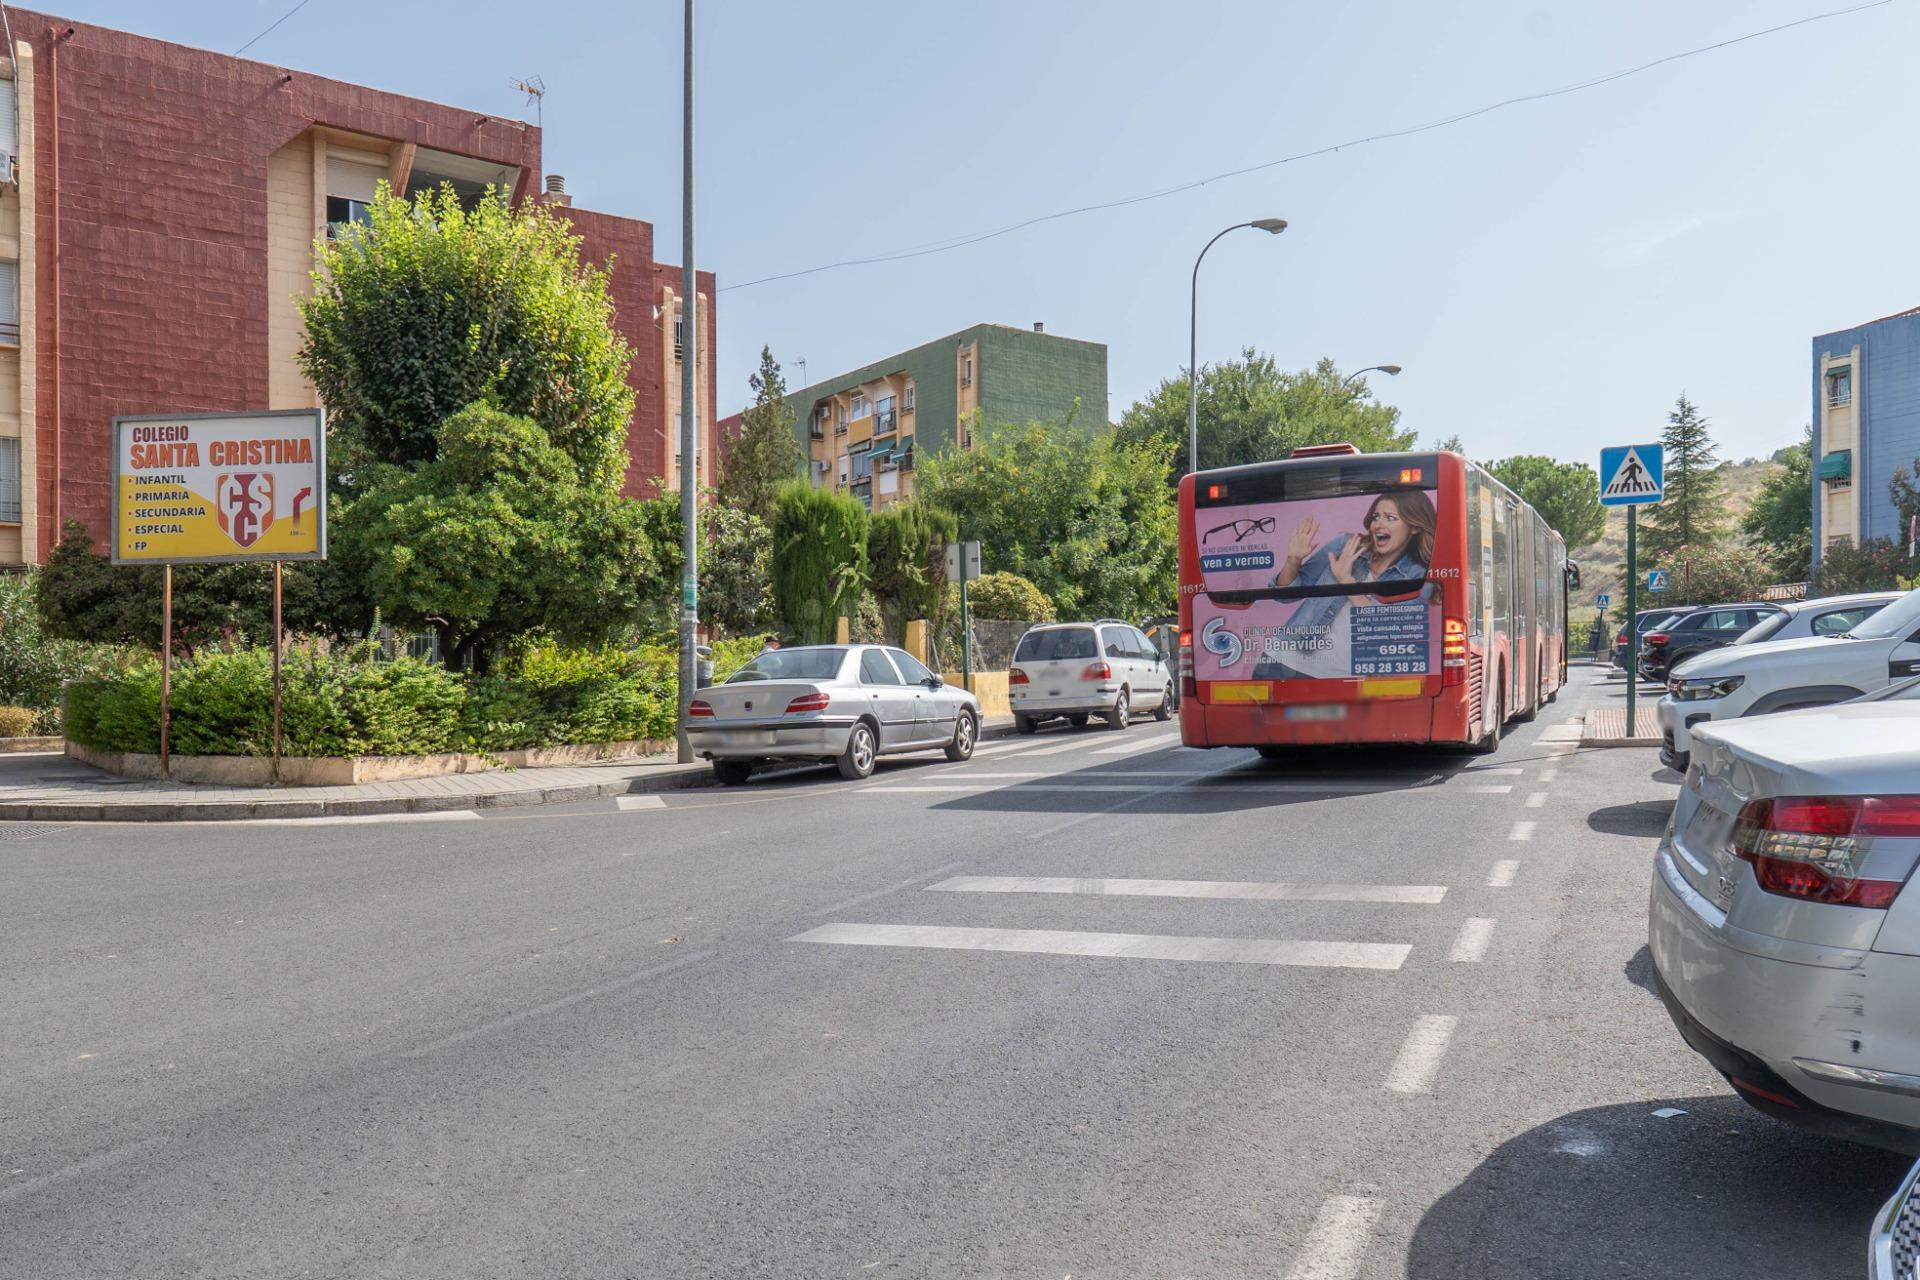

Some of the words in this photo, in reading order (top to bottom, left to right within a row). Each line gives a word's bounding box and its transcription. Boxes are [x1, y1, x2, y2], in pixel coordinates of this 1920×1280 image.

[132, 425, 189, 443] COLEGIO
[130, 442, 200, 469] SANTA
[209, 438, 313, 467] CRISTINA
[135, 475, 187, 485] INFANTIL
[135, 491, 190, 501] PRIMARIA
[135, 506, 206, 518] SECUNDARIA
[135, 524, 185, 534] ESPECIAL
[135, 541, 148, 551] FP
[1203, 558, 1222, 569] ven
[1225, 558, 1232, 567] a
[1234, 555, 1271, 567] vernos
[1427, 567, 1460, 578] 11612
[1272, 623, 1331, 636] OFTALMOLÓGICA
[1356, 625, 1373, 633] vista
[1243, 638, 1261, 652] Dr.
[1264, 636, 1334, 652] Benavides
[1379, 644, 1416, 655] 695€
[1354, 663, 1375, 674] 958
[1378, 662, 1392, 673] 28
[1395, 662, 1409, 673] 38
[1412, 661, 1426, 672] 28
